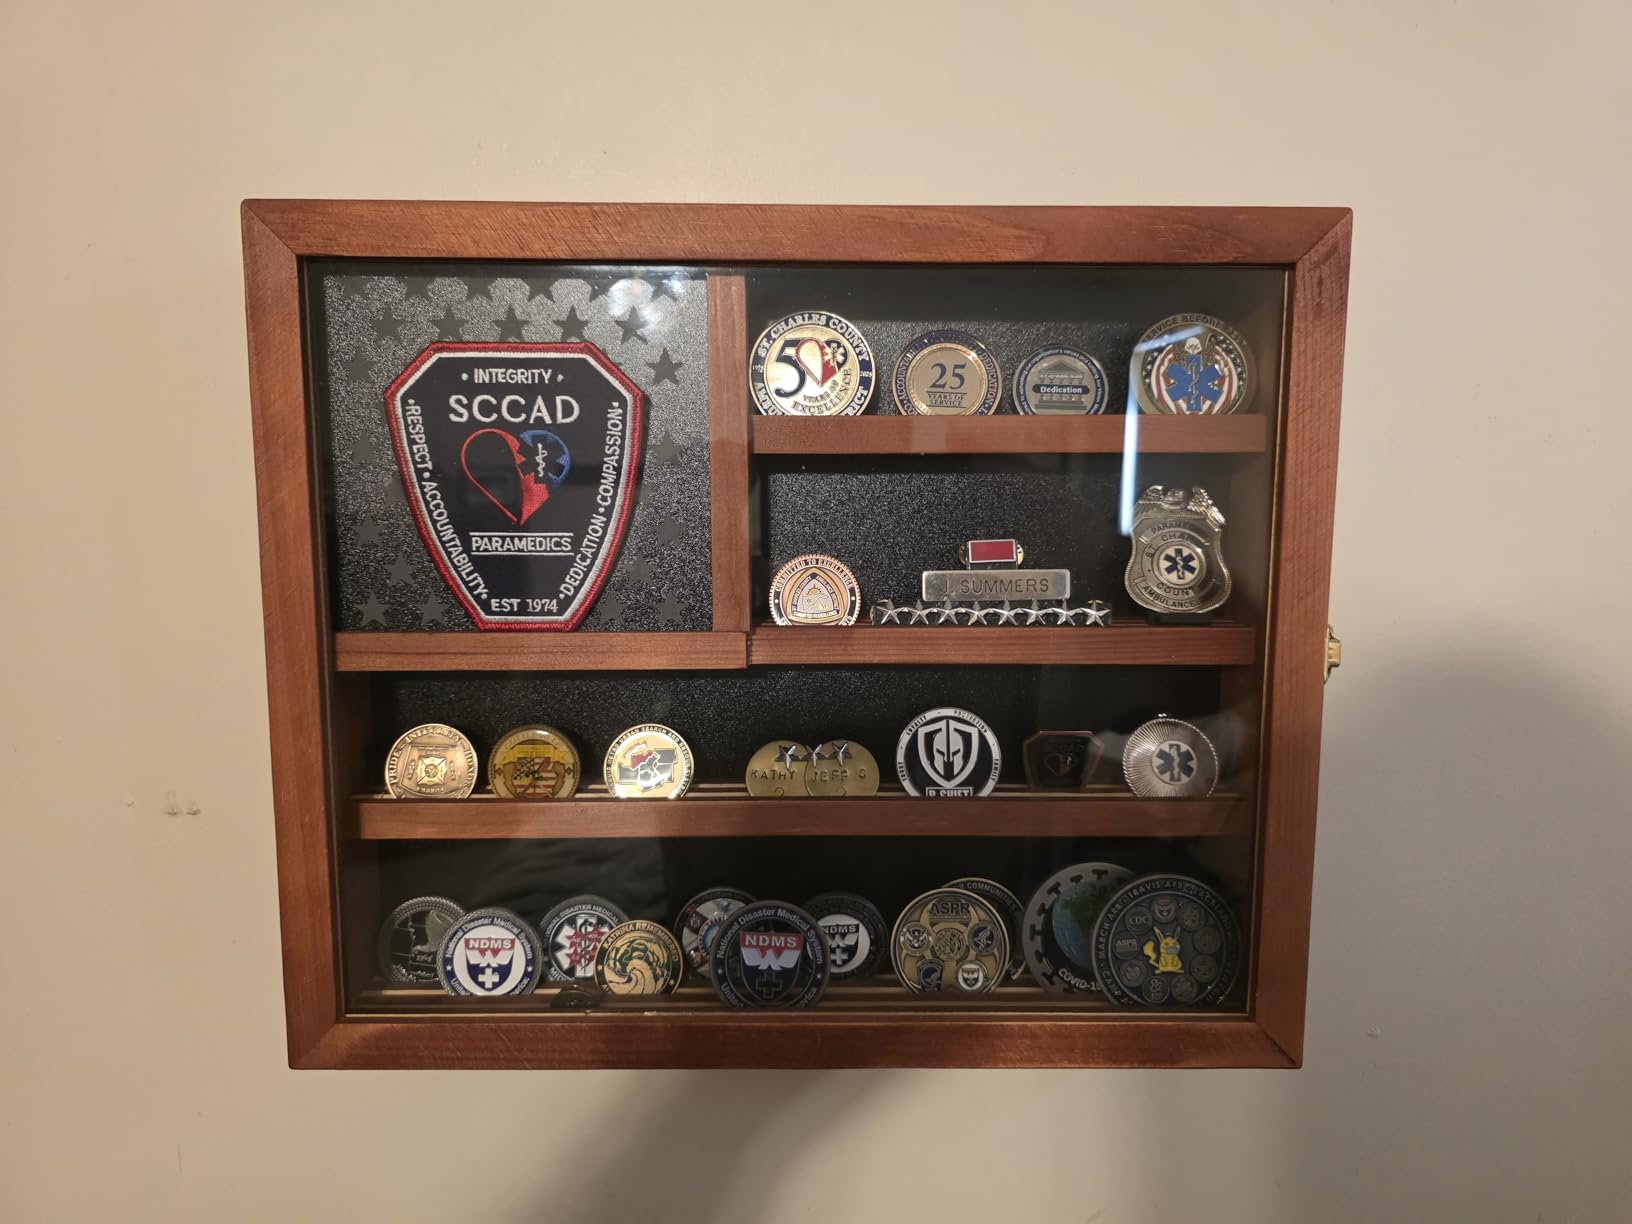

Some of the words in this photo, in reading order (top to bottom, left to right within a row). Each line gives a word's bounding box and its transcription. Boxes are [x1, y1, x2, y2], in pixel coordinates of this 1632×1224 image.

[770, 313, 827, 338] CHARLES
[828, 318, 870, 361] COUNTY
[473, 368, 552, 384] INTEGRITY
[929, 362, 967, 390] 25
[979, 352, 998, 406] DEDICATION
[792, 368, 852, 414] EXCELLENCE
[954, 393, 965, 401] OF
[1040, 386, 1083, 394] Dedication
[449, 394, 580, 424] SCCAD
[405, 404, 431, 471] RESPECT
[421, 481, 489, 597] ACCOUNTABILITY
[560, 514, 608, 597] DEDICATION
[597, 408, 623, 507] COMPASSION
[471, 536, 572, 551] PARAMEDICS
[775, 560, 806, 592] COMMITTED
[818, 559, 854, 588] EXCELLENCE
[943, 580, 954, 594] J.
[960, 578, 1050, 594] SUMMERS
[490, 598, 519, 612] EST
[527, 599, 559, 613] 1974
[1143, 586, 1196, 609] AMBULANCE
[640, 725, 667, 734] SEARCH
[906, 715, 927, 736] LOYALTY
[389, 749, 402, 784] PRIDE
[750, 768, 796, 780] KATHY
[811, 769, 849, 782] JEFF
[990, 759, 999, 781] FAMILY
[1128, 880, 1161, 899] TRAVIS
[560, 904, 592, 918] DISASTER
[592, 905, 619, 924] MEDICAL
[929, 902, 971, 914] ASPR
[823, 924, 857, 934] NDMS
[1129, 916, 1148, 925] CDC
[462, 917, 492, 932] Disaster
[493, 916, 522, 936] Medical
[518, 931, 533, 959] System
[469, 939, 512, 949] NDMS
[604, 923, 634, 949] KATRINA
[635, 923, 679, 962] REMEMBERED
[716, 922, 740, 959] National
[738, 908, 776, 926] Disaster
[777, 908, 810, 931] Medical
[806, 929, 824, 964] System
[744, 934, 798, 948] NDMS
